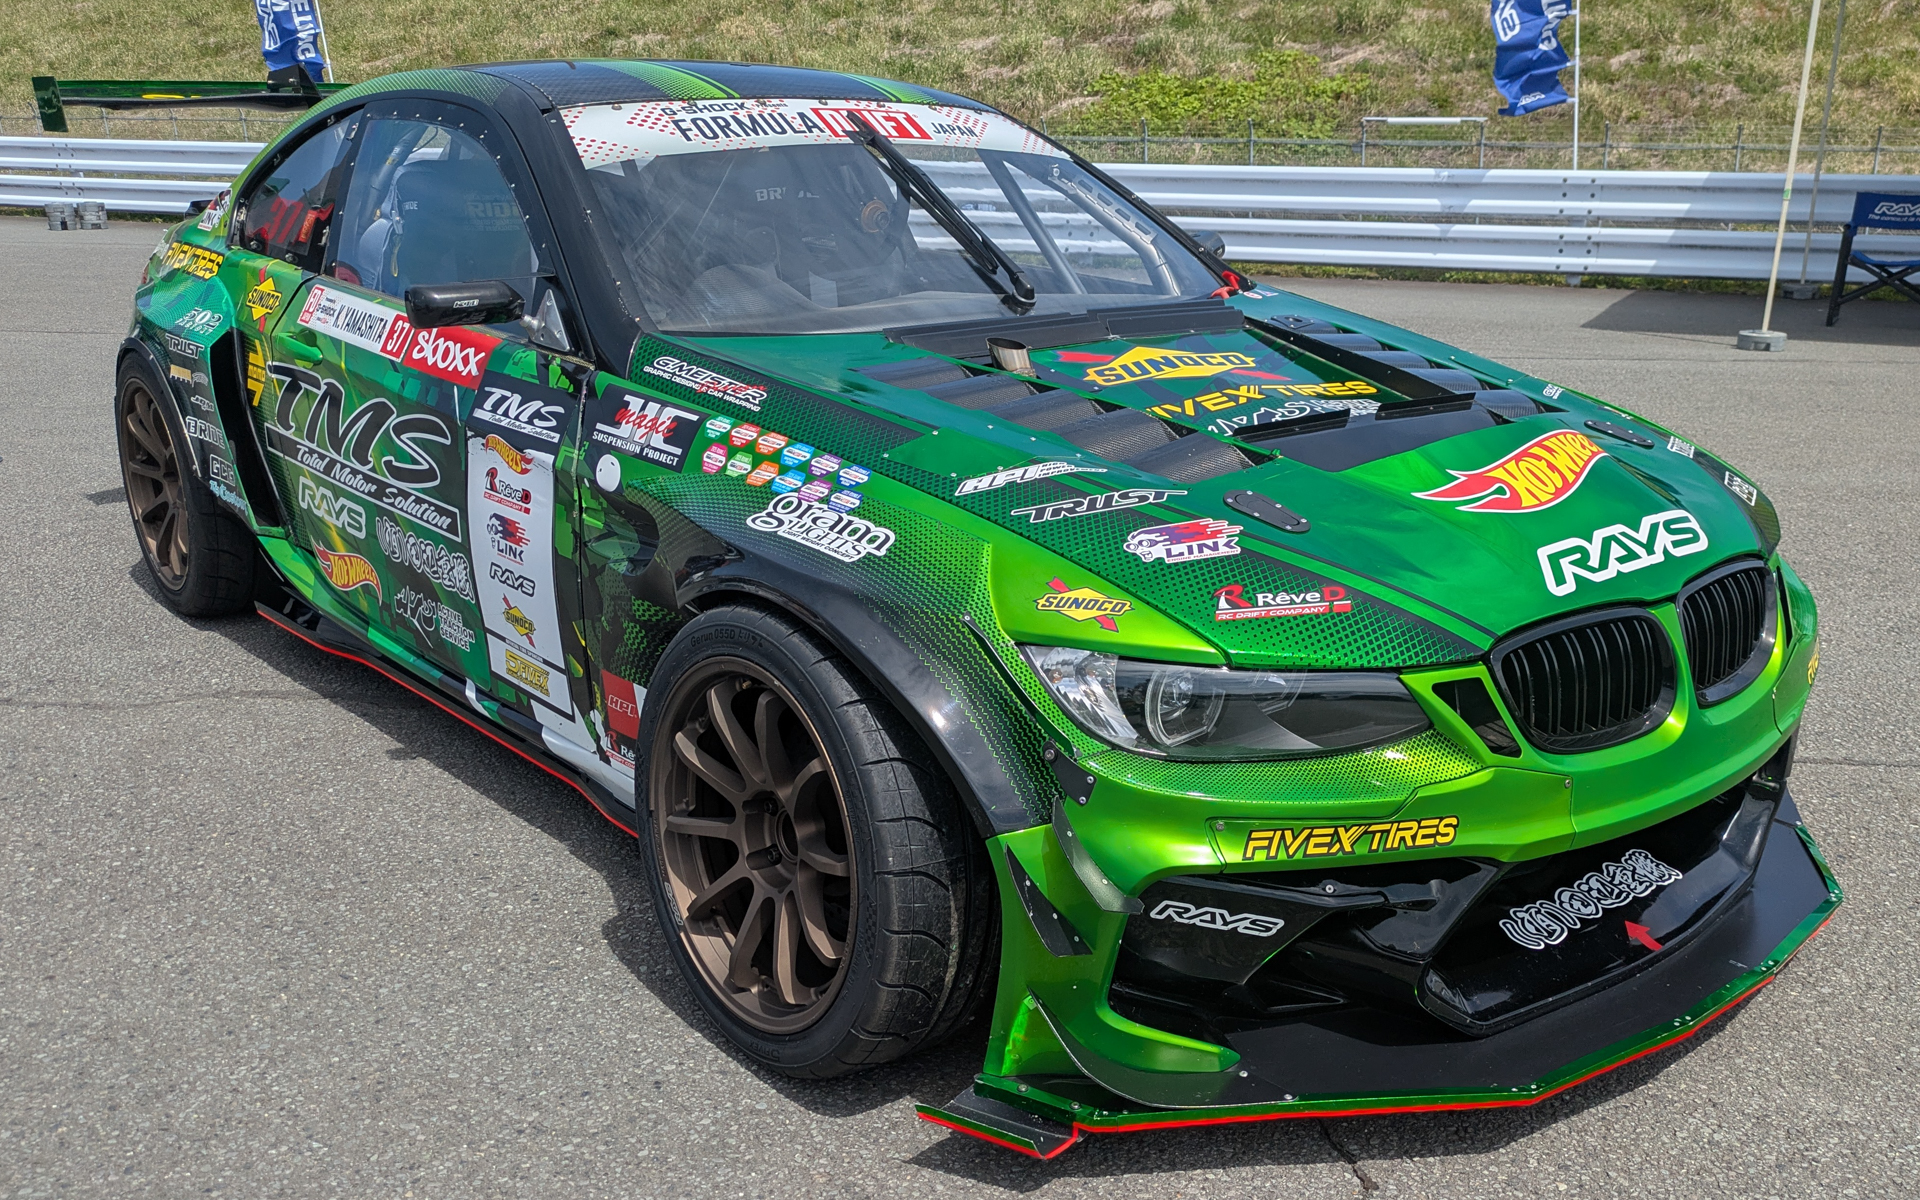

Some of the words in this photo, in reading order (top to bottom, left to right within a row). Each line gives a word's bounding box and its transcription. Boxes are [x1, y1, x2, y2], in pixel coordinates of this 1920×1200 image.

[660, 102, 751, 117] G-SHOCK
[670, 111, 827, 142] FORMULA
[931, 122, 978, 138] JAPAN
[249, 287, 280, 312] SUNOCO
[386, 319, 410, 353] 37
[1100, 353, 1246, 381] SUNOCO
[643, 366, 672, 380] GRAPHIC
[708, 388, 724, 398] CAR
[723, 394, 761, 412] WRAPPING
[1262, 381, 1379, 397] TIRES
[483, 386, 565, 428] TMS
[614, 407, 678, 441] magic
[186, 416, 225, 449] BRIDE
[266, 361, 451, 488] TMS
[592, 430, 642, 454] SUSPENSION
[643, 447, 679, 467] PROJECT
[297, 445, 330, 473] Total
[330, 463, 378, 494] Motor
[383, 488, 452, 529] Solution
[299, 476, 366, 539] RAYS
[1010, 489, 1188, 523] TRUST
[782, 529, 800, 539] LIGHT
[800, 536, 826, 548] WEIGHT
[824, 545, 856, 561] CONCEPT
[786, 520, 867, 557] LIGHTS
[1537, 510, 1708, 596] RAYS
[489, 561, 536, 598] RAYS
[1040, 595, 1128, 613] SUNOCO
[1235, 611, 1267, 619] DRIFT
[1272, 606, 1326, 616] COMPANY
[440, 616, 475, 643] TRACTION
[505, 611, 534, 633] SUNOCO
[440, 627, 470, 652] SERVICE
[1149, 898, 1285, 937] RAYS
